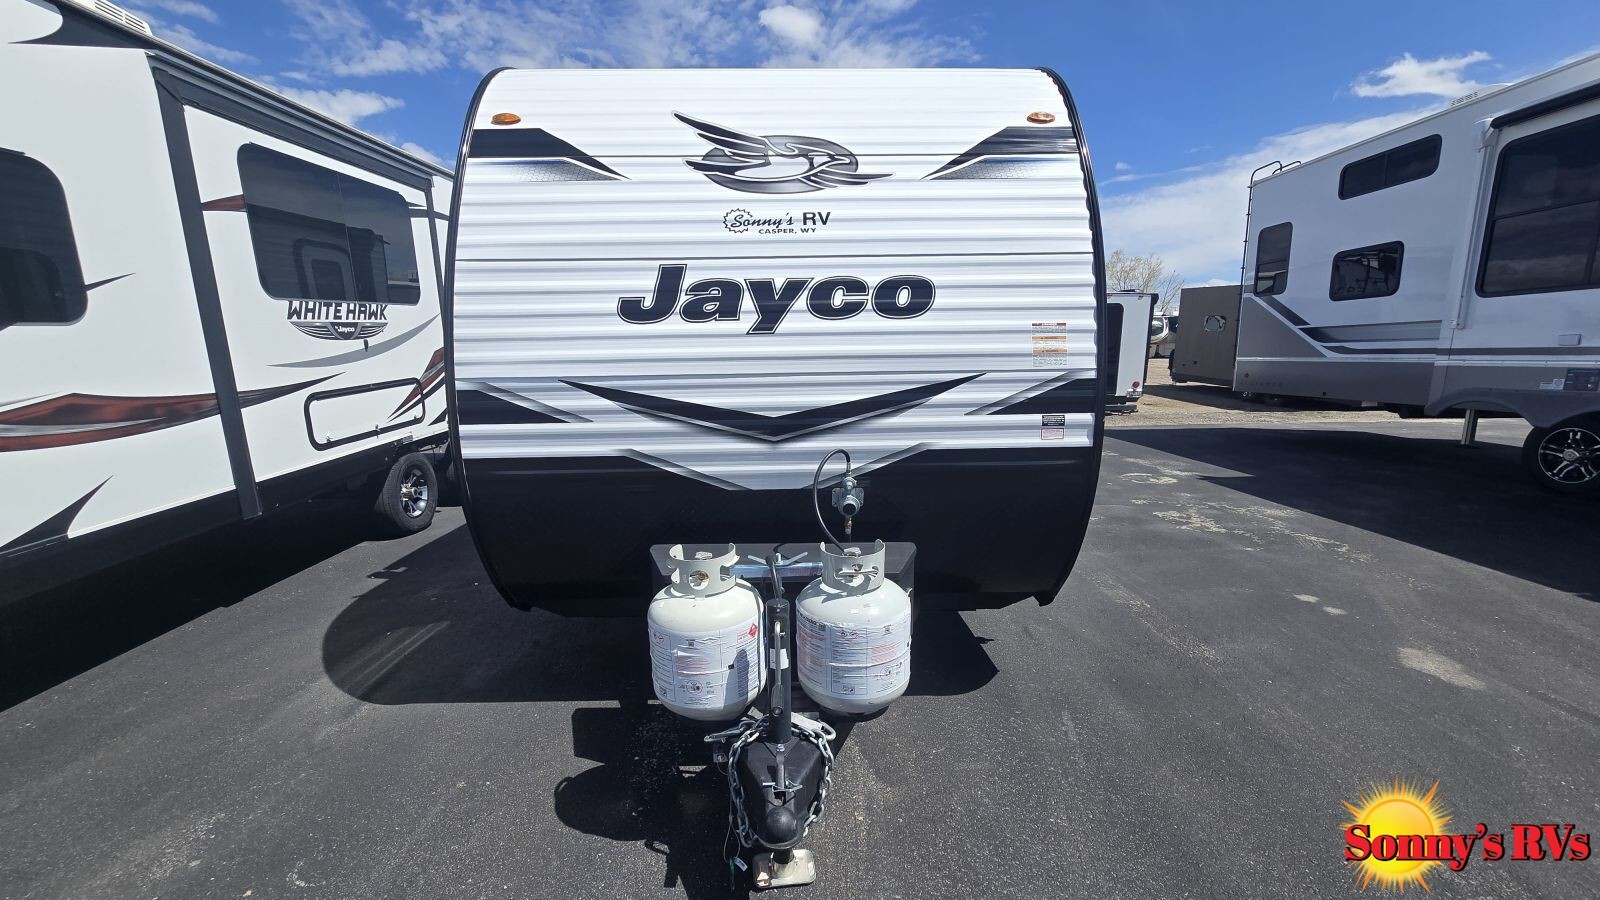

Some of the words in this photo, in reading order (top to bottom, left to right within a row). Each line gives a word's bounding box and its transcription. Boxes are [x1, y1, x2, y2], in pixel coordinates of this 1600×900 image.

[730, 212, 794, 229] Sonny's
[802, 211, 831, 226] RV
[758, 227, 798, 235] CASPER,
[617, 263, 936, 335] Jayco
[287, 300, 342, 320] WHITE
[346, 302, 388, 320] HAWK
